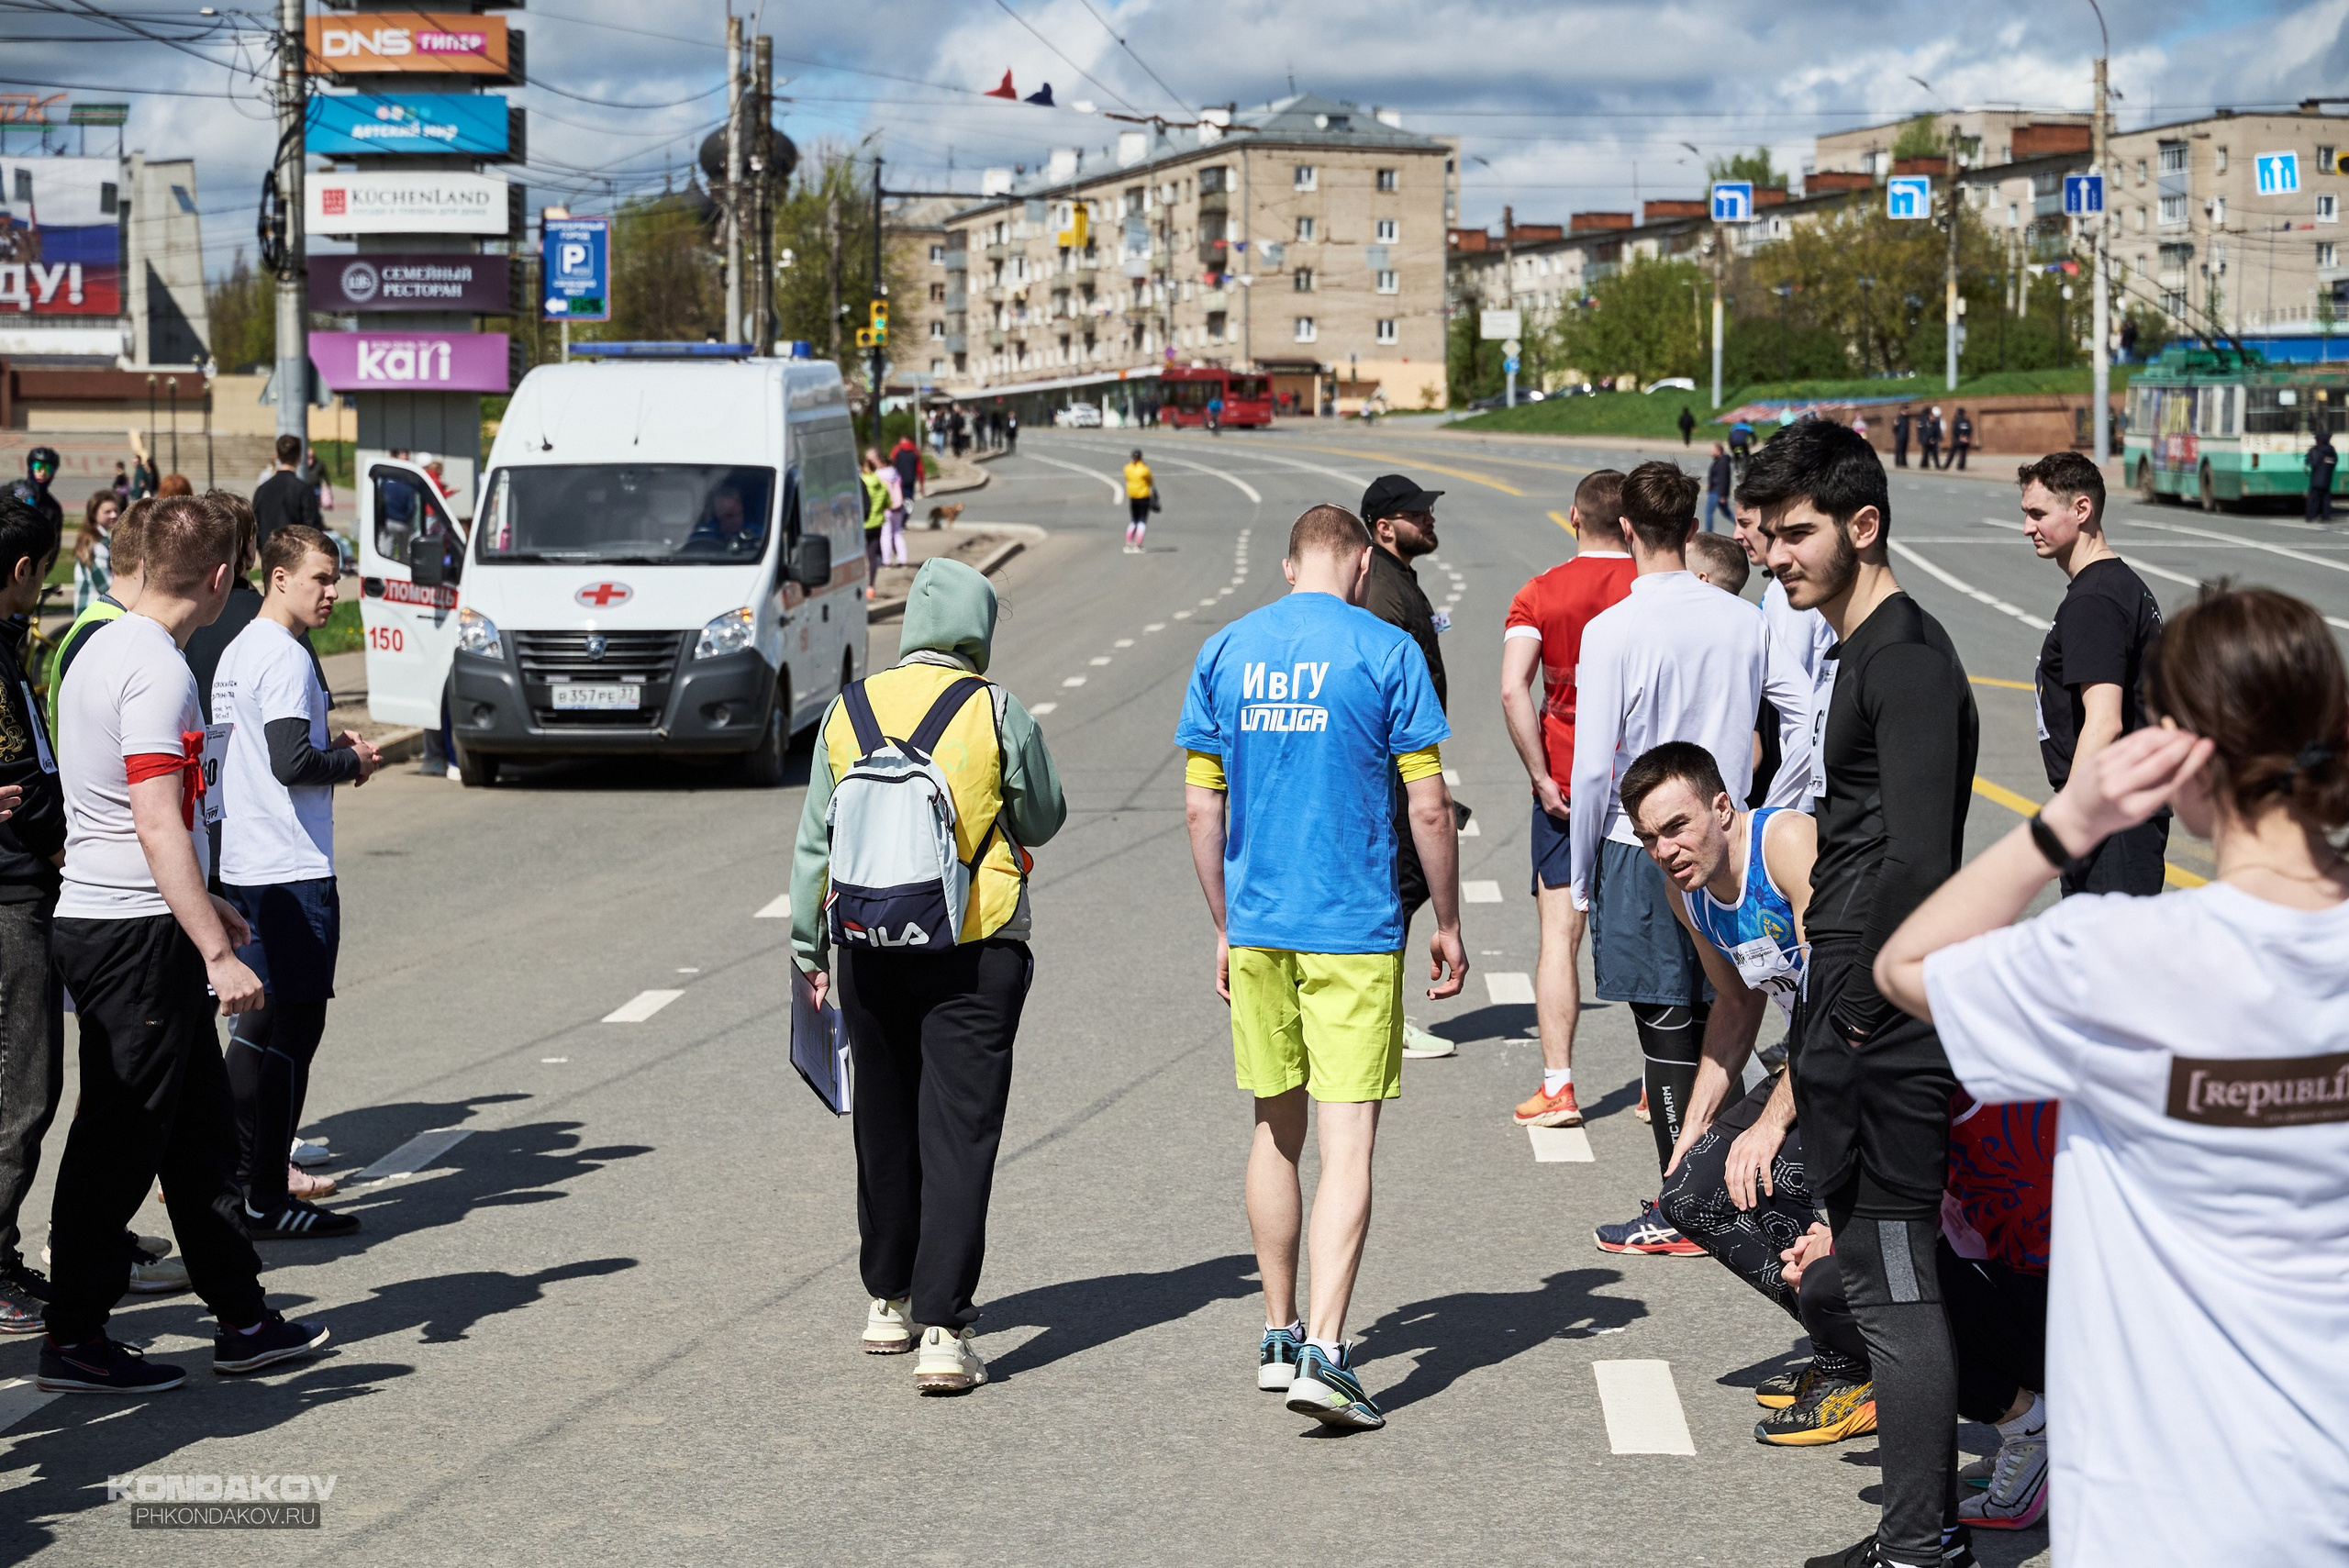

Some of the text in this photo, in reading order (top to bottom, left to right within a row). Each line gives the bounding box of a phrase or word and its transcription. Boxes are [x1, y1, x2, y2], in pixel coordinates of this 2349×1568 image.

[322, 28, 412, 57] DNS
[382, 265, 473, 282] СЕМЕЙНЫЙ
[384, 284, 462, 298] РЕСТОРАН
[358, 340, 451, 381] kari
[389, 582, 455, 607] ПОМОЩЬ
[370, 628, 403, 651] 150
[1242, 662, 1330, 700] ИвГУ
[1241, 708, 1329, 732] UNILIGA
[843, 921, 930, 948] FILA
[1662, 1085, 1677, 1124] WARM
